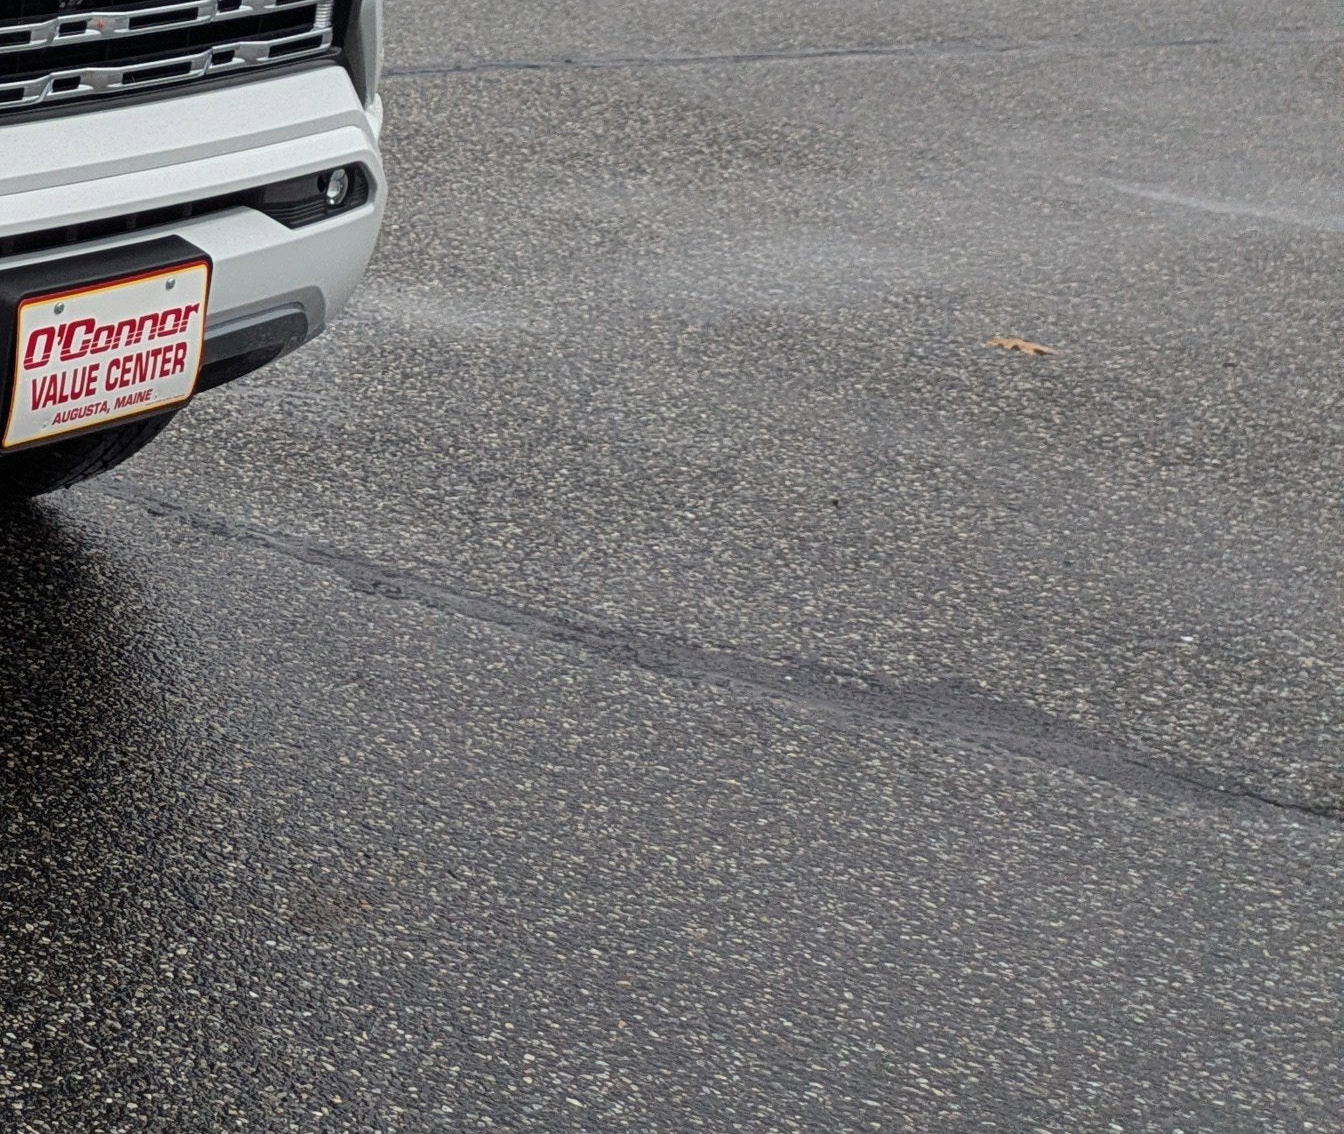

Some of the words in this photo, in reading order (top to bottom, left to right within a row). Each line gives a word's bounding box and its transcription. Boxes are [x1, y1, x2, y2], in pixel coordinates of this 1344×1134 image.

[22, 302, 201, 371] O'Connor
[31, 362, 101, 411] VALUE
[104, 341, 188, 392] CENTER
[51, 400, 111, 426] AUGUSTA,
[113, 388, 154, 410] MAINE
